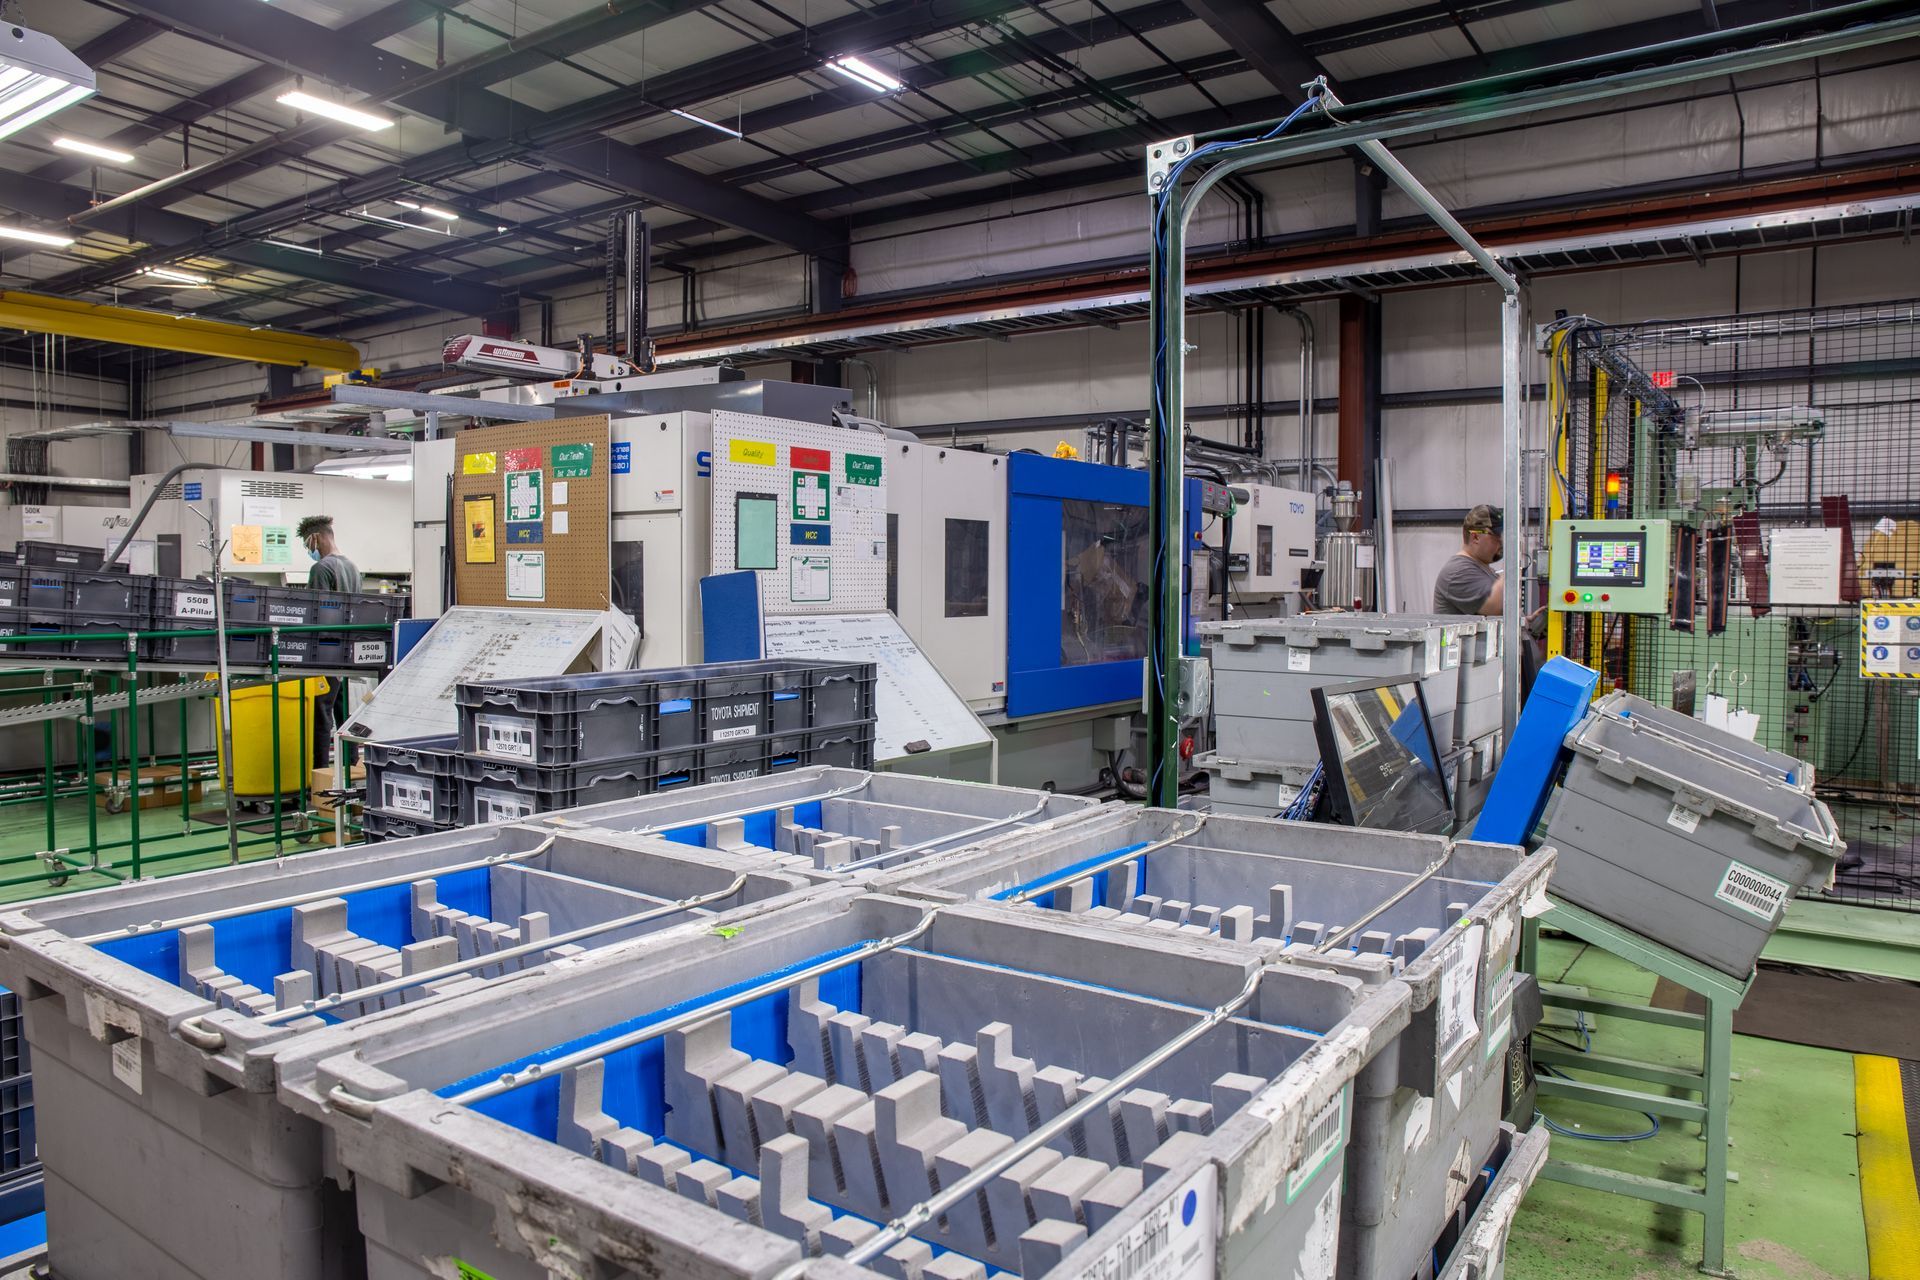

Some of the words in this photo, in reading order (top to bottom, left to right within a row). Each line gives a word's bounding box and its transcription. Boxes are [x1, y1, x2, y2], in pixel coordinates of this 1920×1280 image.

[559, 452, 569, 461] Our
[570, 451, 585, 460] Team
[743, 447, 764, 459] Quality
[852, 461, 862, 469] Our
[862, 462, 875, 470] Team
[566, 469, 576, 477] 2nd
[579, 468, 588, 476] 3rd
[857, 476, 866, 484] 2nd
[869, 477, 877, 485] 3rd
[1289, 502, 1305, 514] TOYO
[805, 531, 818, 539] WCC
[187, 596, 209, 605] 550B
[181, 607, 213, 616] A-Pillar
[269, 604, 285, 613] TOYOTA
[286, 606, 307, 615] SHIPMENT
[287, 641, 307, 650] SHIPMENT
[711, 705, 732, 720] TOYOTA
[733, 702, 759, 718] SHIPMENT
[722, 730, 734, 738] 12570
[1728, 869, 1782, 902] C000000044
